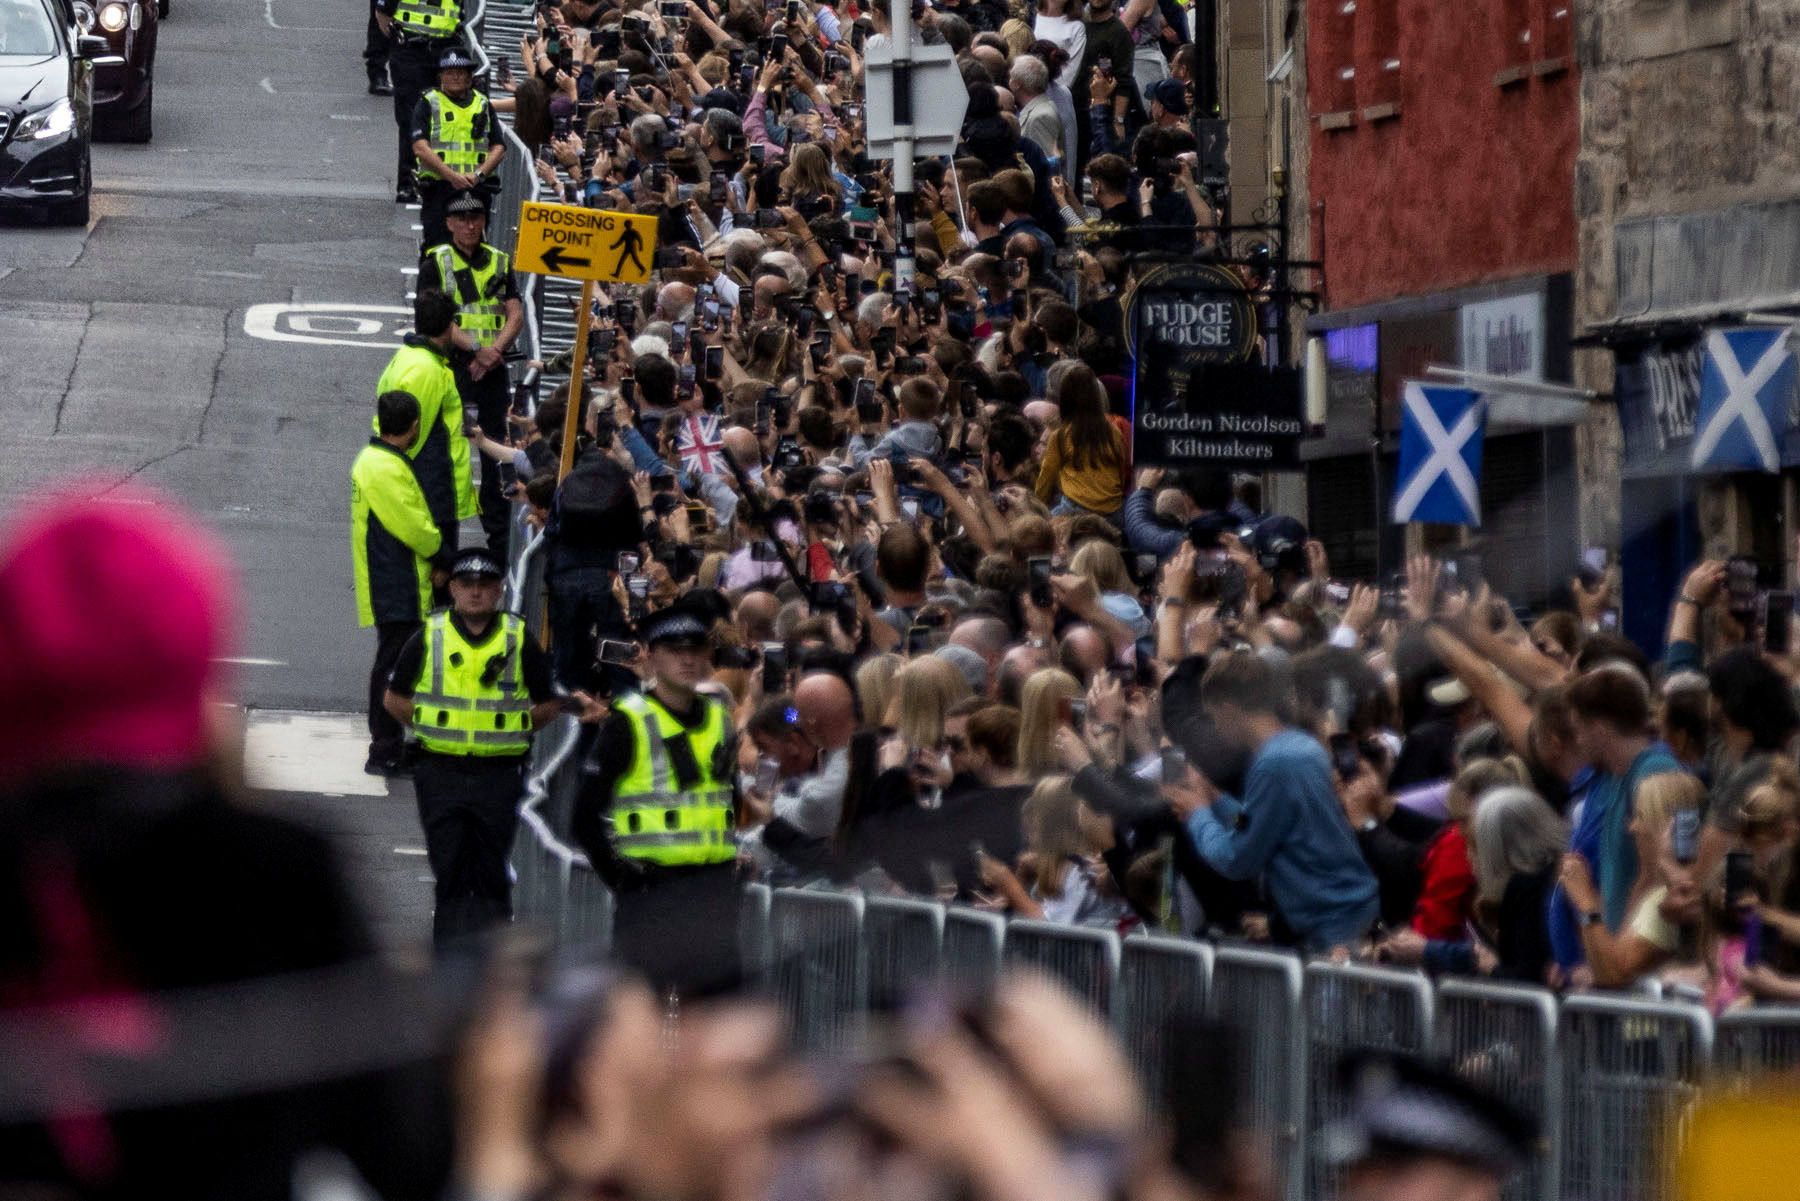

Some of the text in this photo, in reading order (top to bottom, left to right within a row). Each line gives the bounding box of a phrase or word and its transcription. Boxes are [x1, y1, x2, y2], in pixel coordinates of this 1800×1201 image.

[526, 207, 615, 232] CROSSING
[542, 228, 594, 248] POINT
[1148, 303, 1233, 327] FUDGE
[1142, 413, 1301, 433] Gordon Nicolson
[1168, 438, 1273, 458] Kiltmakers
